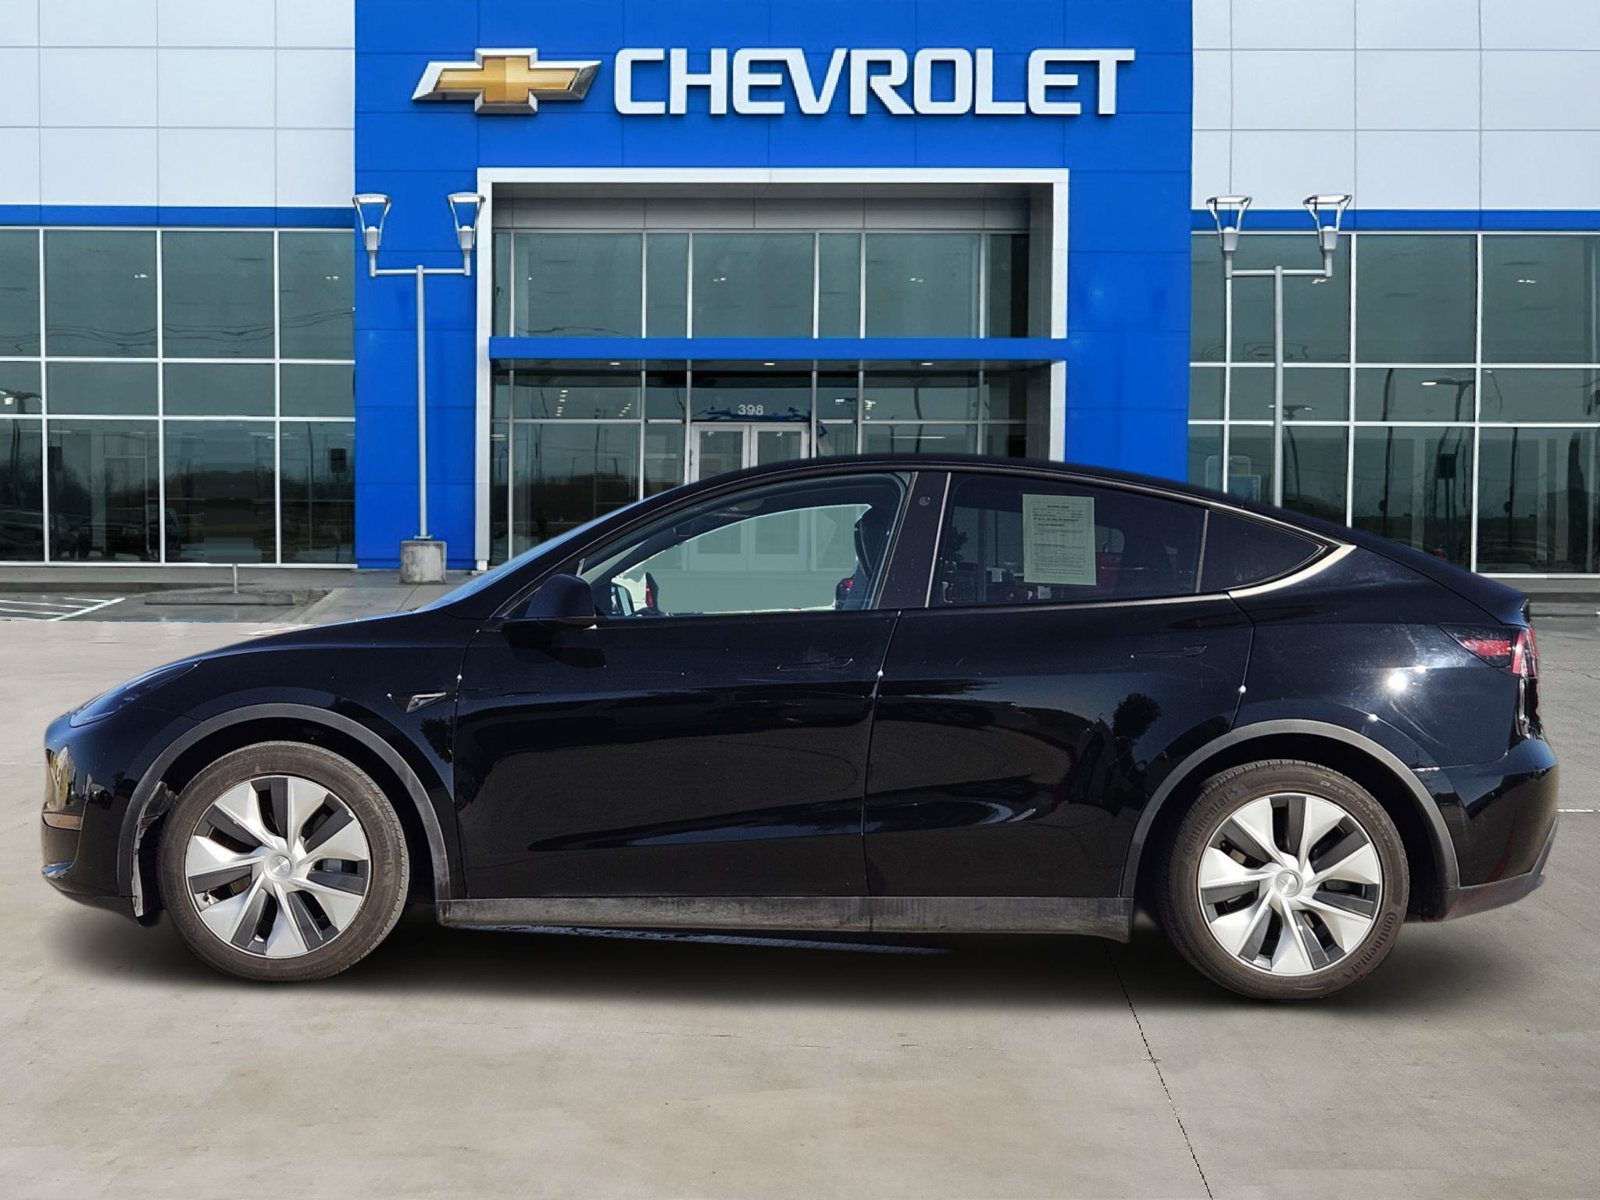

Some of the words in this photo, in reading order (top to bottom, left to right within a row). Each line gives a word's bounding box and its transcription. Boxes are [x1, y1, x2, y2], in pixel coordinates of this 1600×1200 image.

[614, 47, 1135, 116] CHEVROLET
[737, 403, 764, 416] 398
[1183, 792, 1229, 855] Continental
[1351, 911, 1398, 974] Continental
